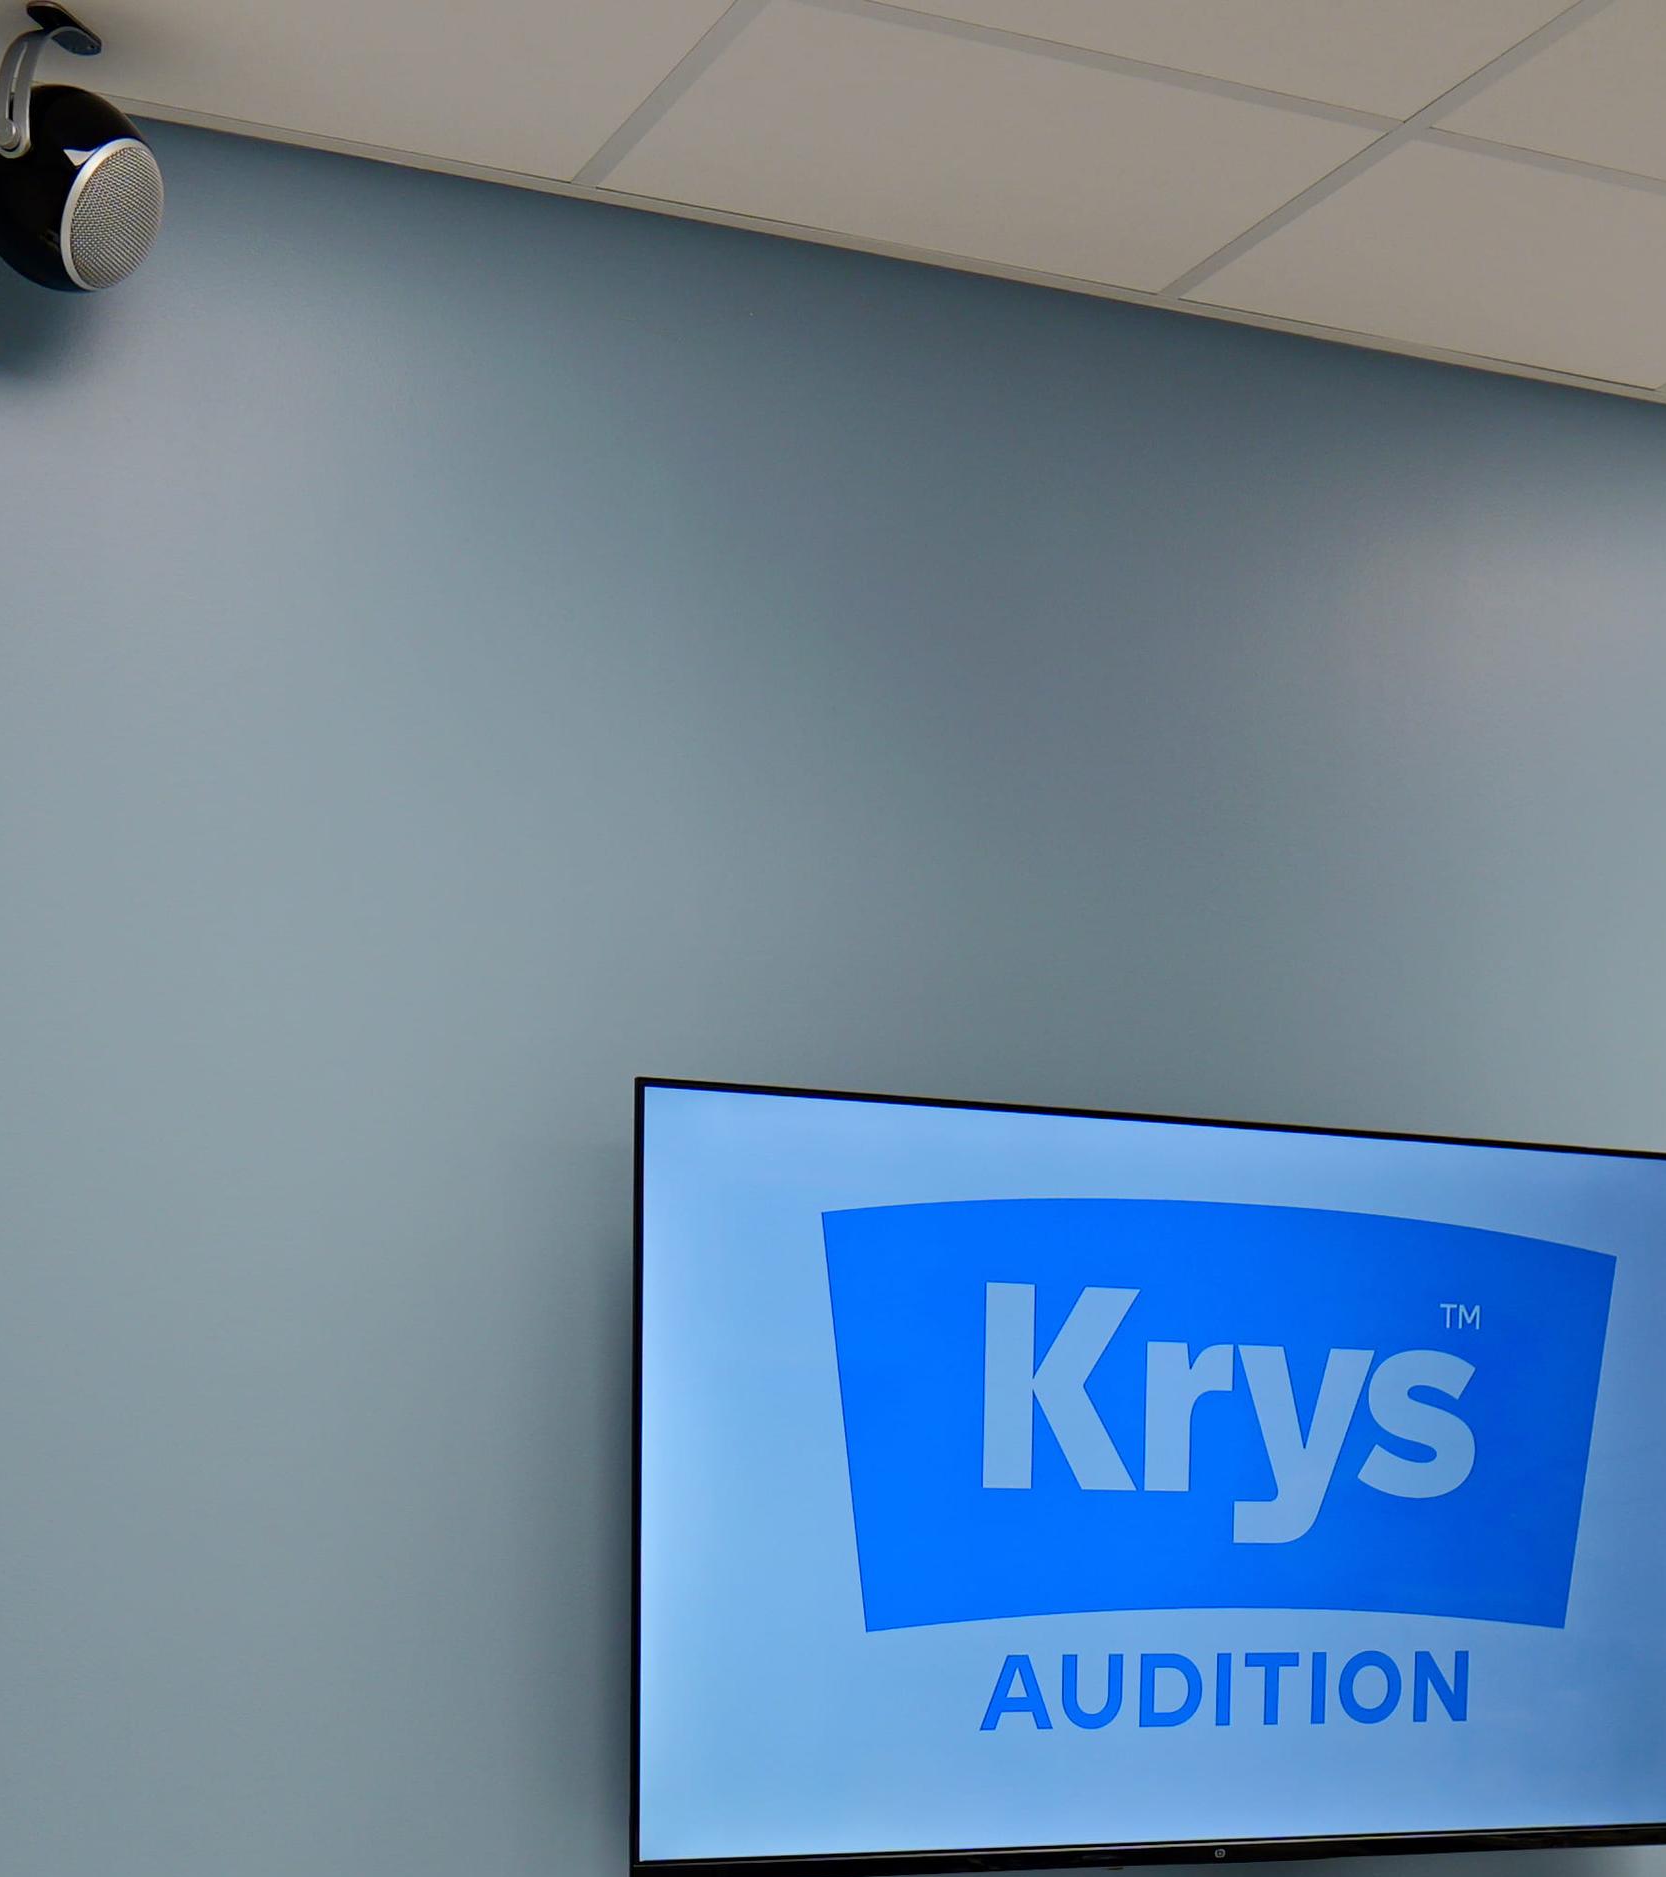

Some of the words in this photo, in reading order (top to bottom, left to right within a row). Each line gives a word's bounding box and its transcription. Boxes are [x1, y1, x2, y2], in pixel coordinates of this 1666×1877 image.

[1440, 1303, 1481, 1330] TM
[982, 1282, 1476, 1544] Krys
[979, 1649, 1470, 1732] AUDITION
